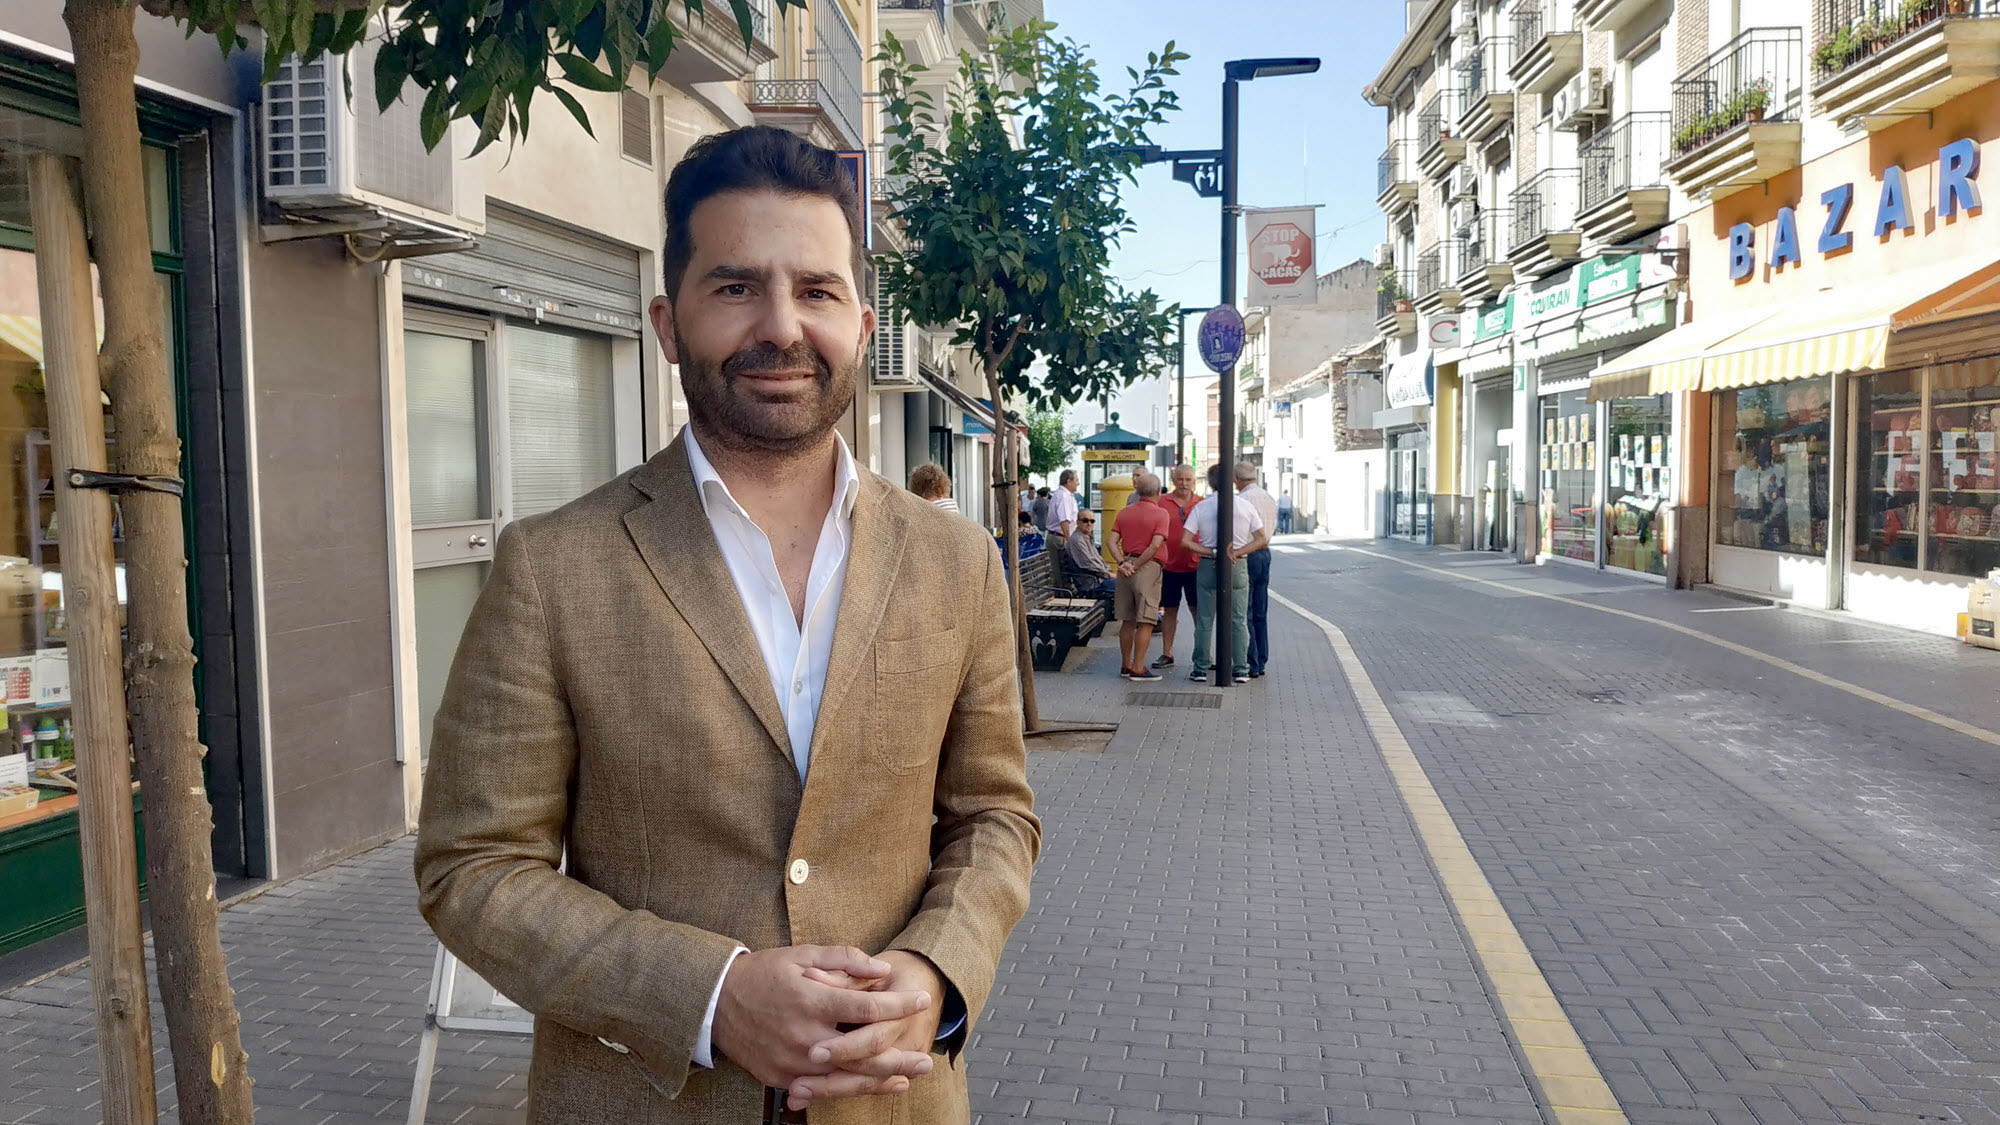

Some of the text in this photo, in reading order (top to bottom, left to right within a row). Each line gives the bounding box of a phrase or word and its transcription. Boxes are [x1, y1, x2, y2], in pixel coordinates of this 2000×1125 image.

[1729, 137, 1983, 280] BAZAR
[1262, 228, 1300, 243] STOP
[1260, 265, 1302, 279] CACAS
